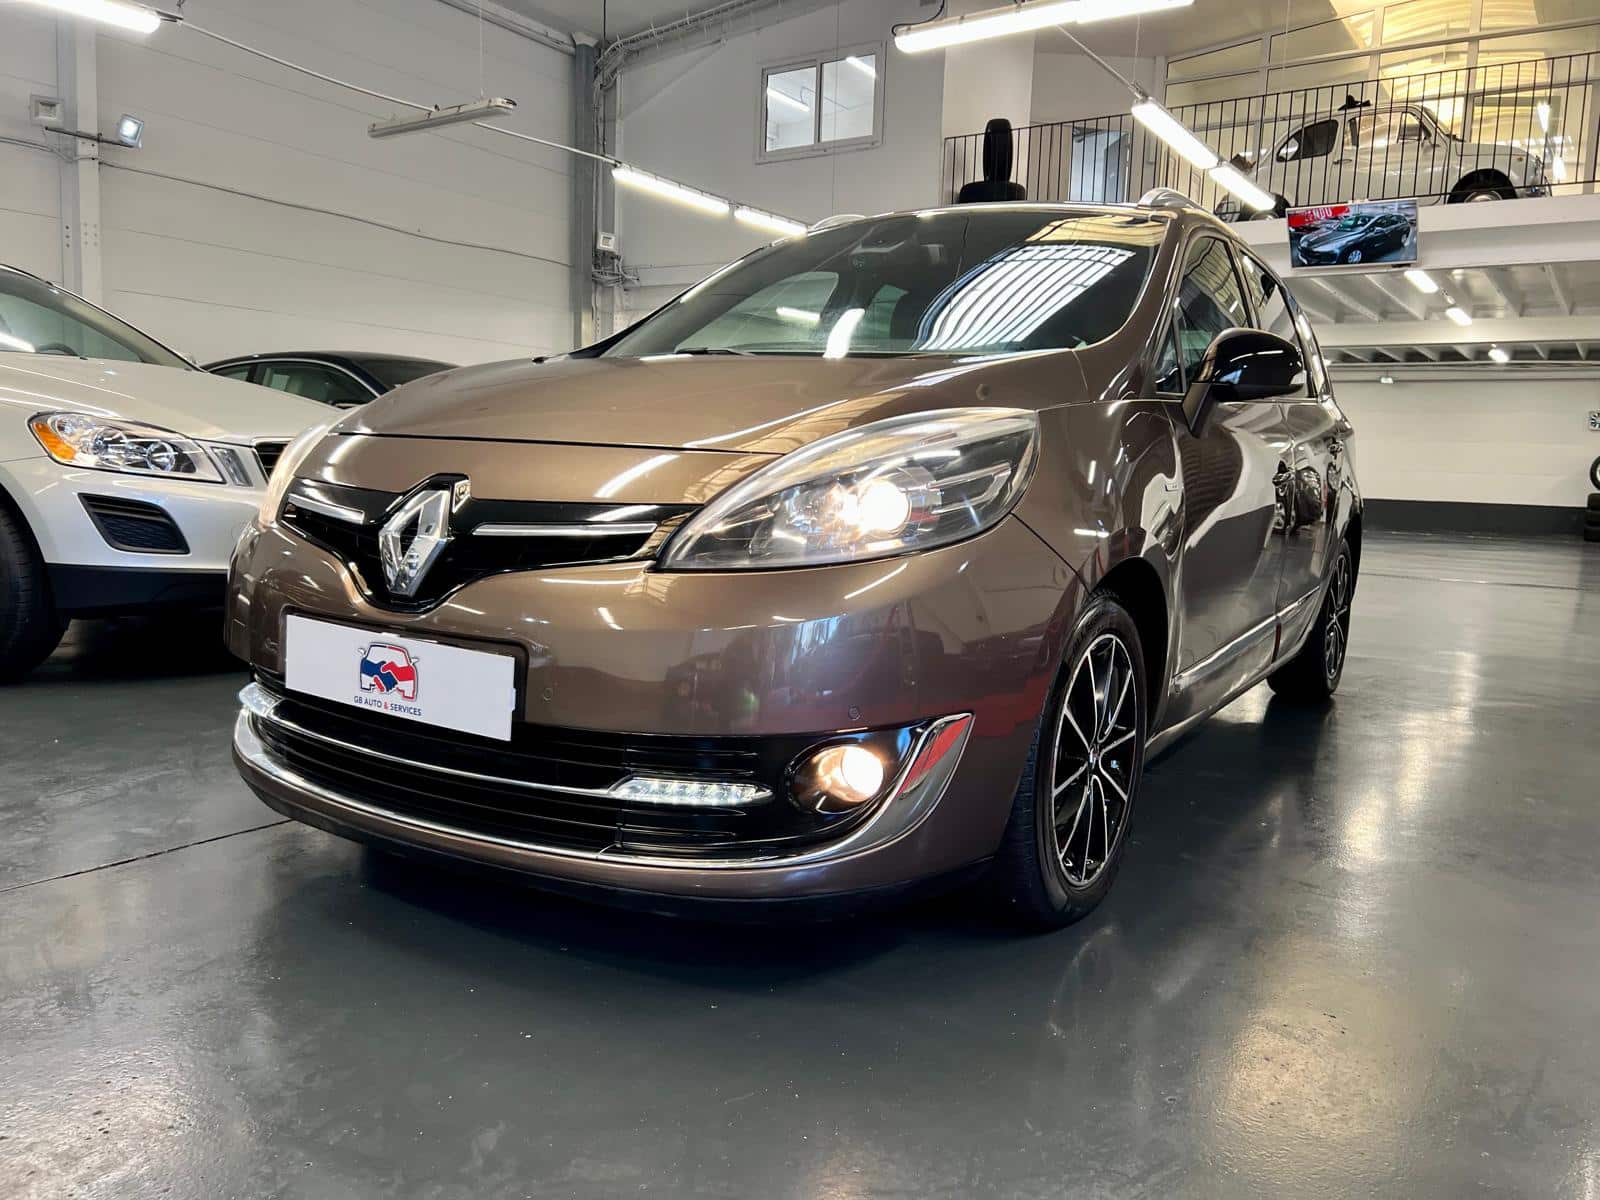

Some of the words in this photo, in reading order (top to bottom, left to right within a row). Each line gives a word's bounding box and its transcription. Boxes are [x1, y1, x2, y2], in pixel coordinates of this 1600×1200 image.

[354, 695, 363, 704] GB
[364, 698, 382, 708] AUTO
[383, 701, 388, 709] &
[390, 703, 422, 716] SERVICES
